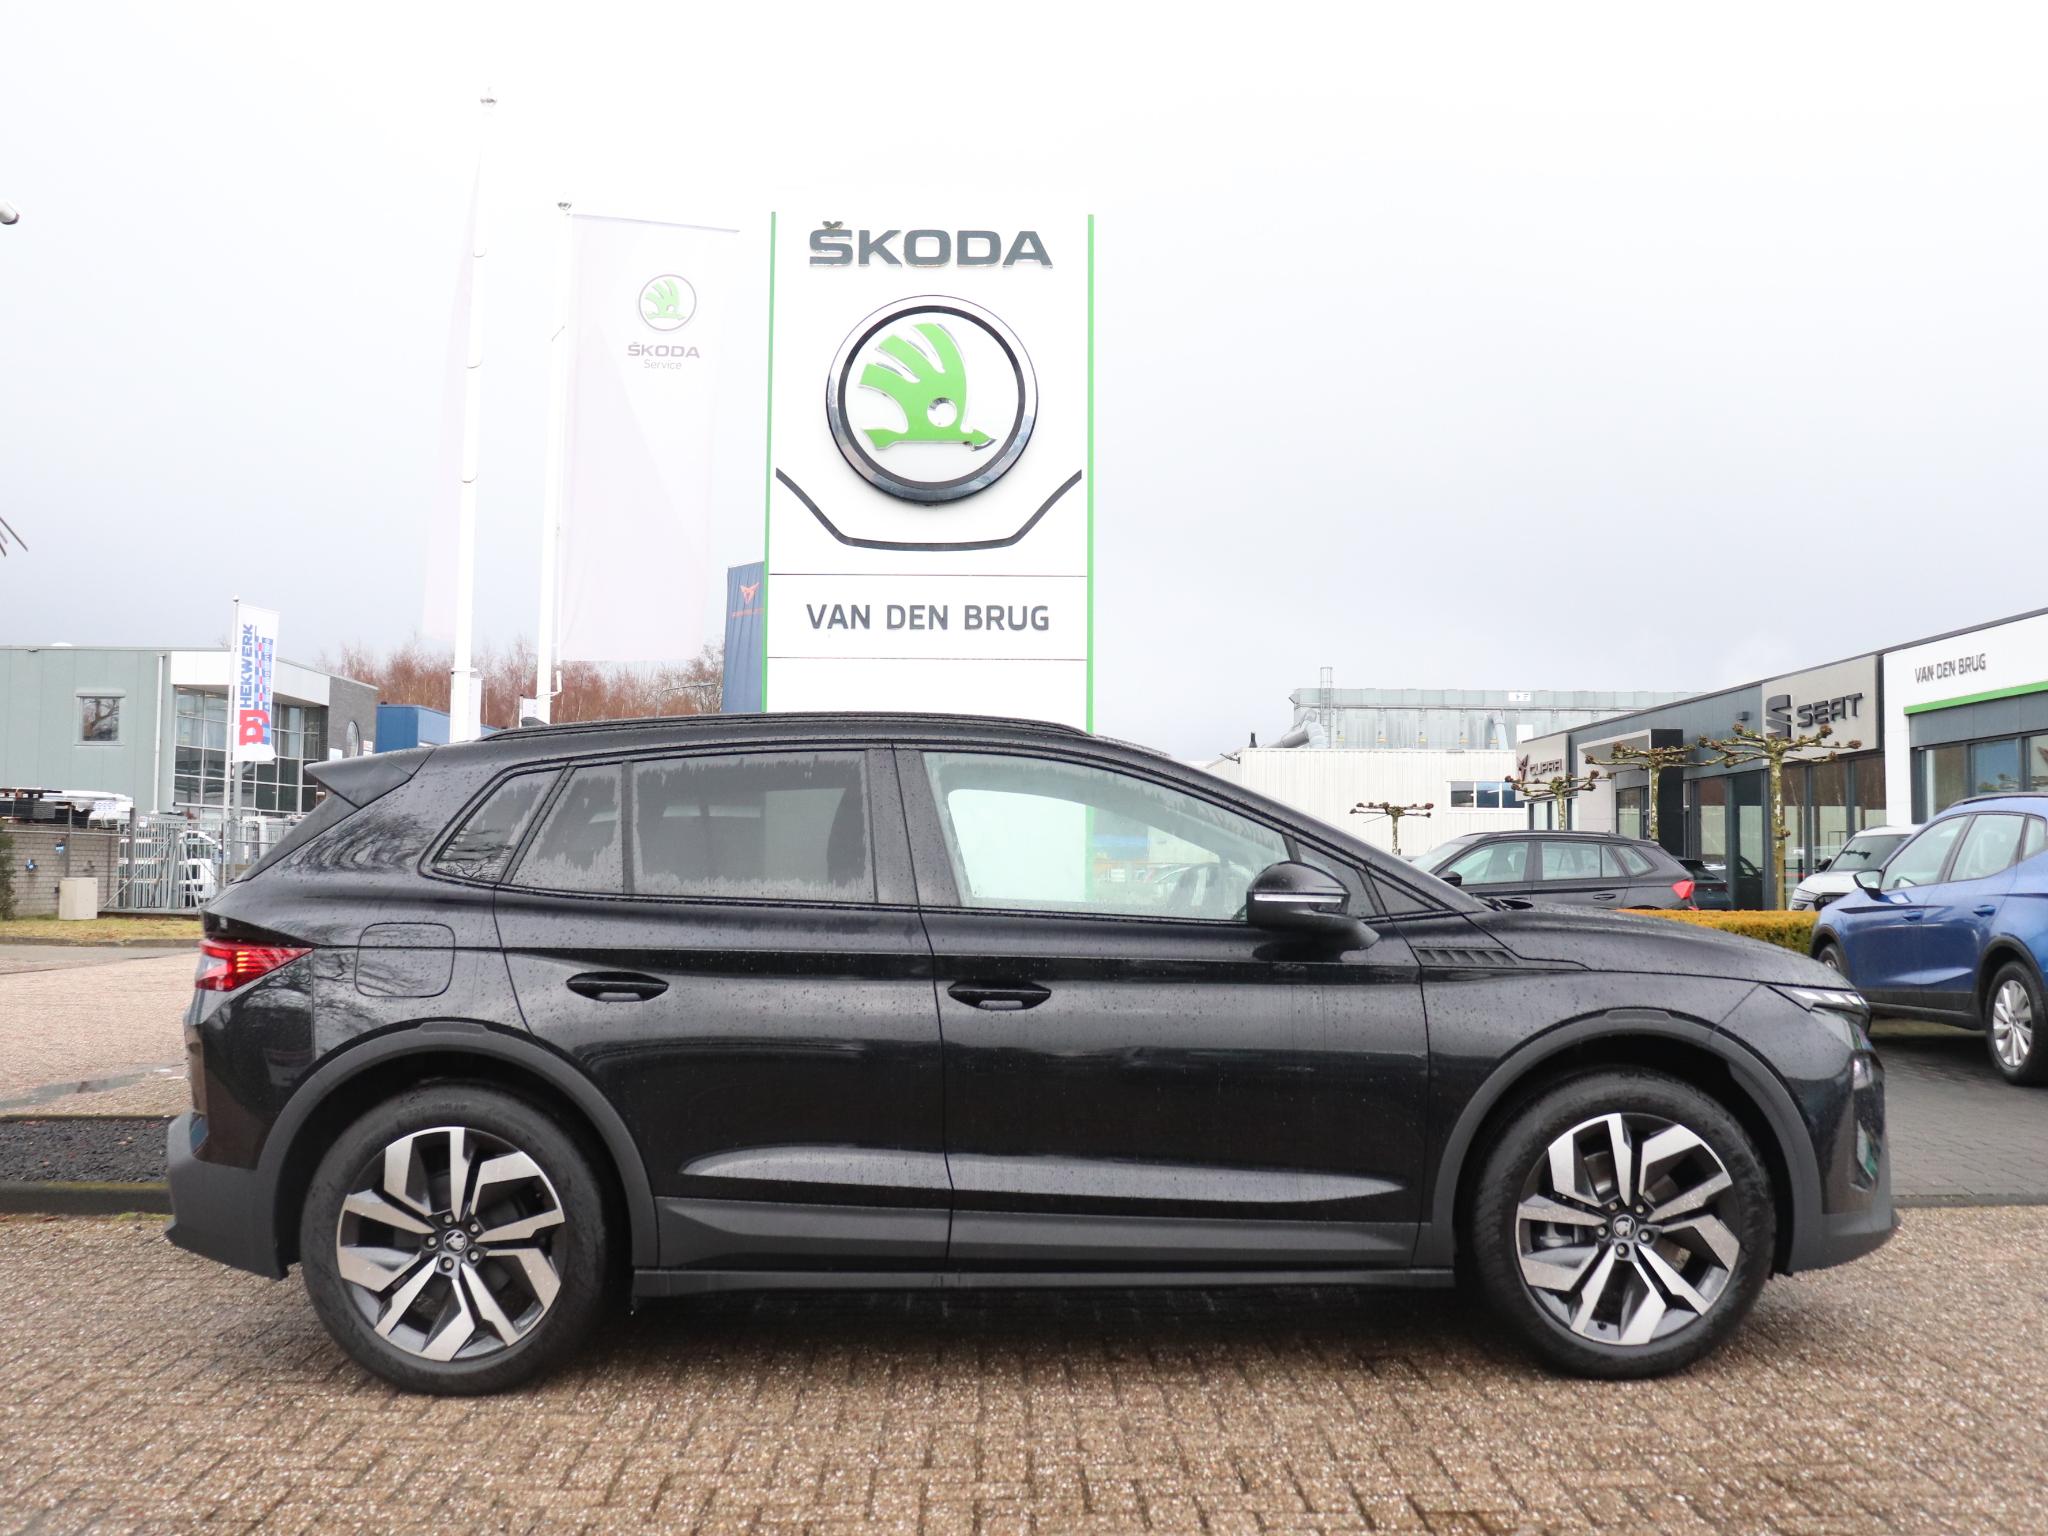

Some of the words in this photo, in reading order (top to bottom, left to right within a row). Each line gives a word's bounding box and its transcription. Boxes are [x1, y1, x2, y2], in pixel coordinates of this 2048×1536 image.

[809, 220, 1053, 269] ŠKODA
[627, 341, 700, 359] ŠKODA
[643, 359, 682, 370] Service
[806, 603, 871, 630] VAN
[886, 604, 948, 631] DEN
[963, 605, 1049, 631] BRUG
[239, 623, 254, 708] HEKWERK
[1914, 664, 1935, 684] VAN
[1936, 660, 1956, 680] DEN
[1958, 652, 1987, 675] BRUG
[1796, 692, 1864, 728] SEAT
